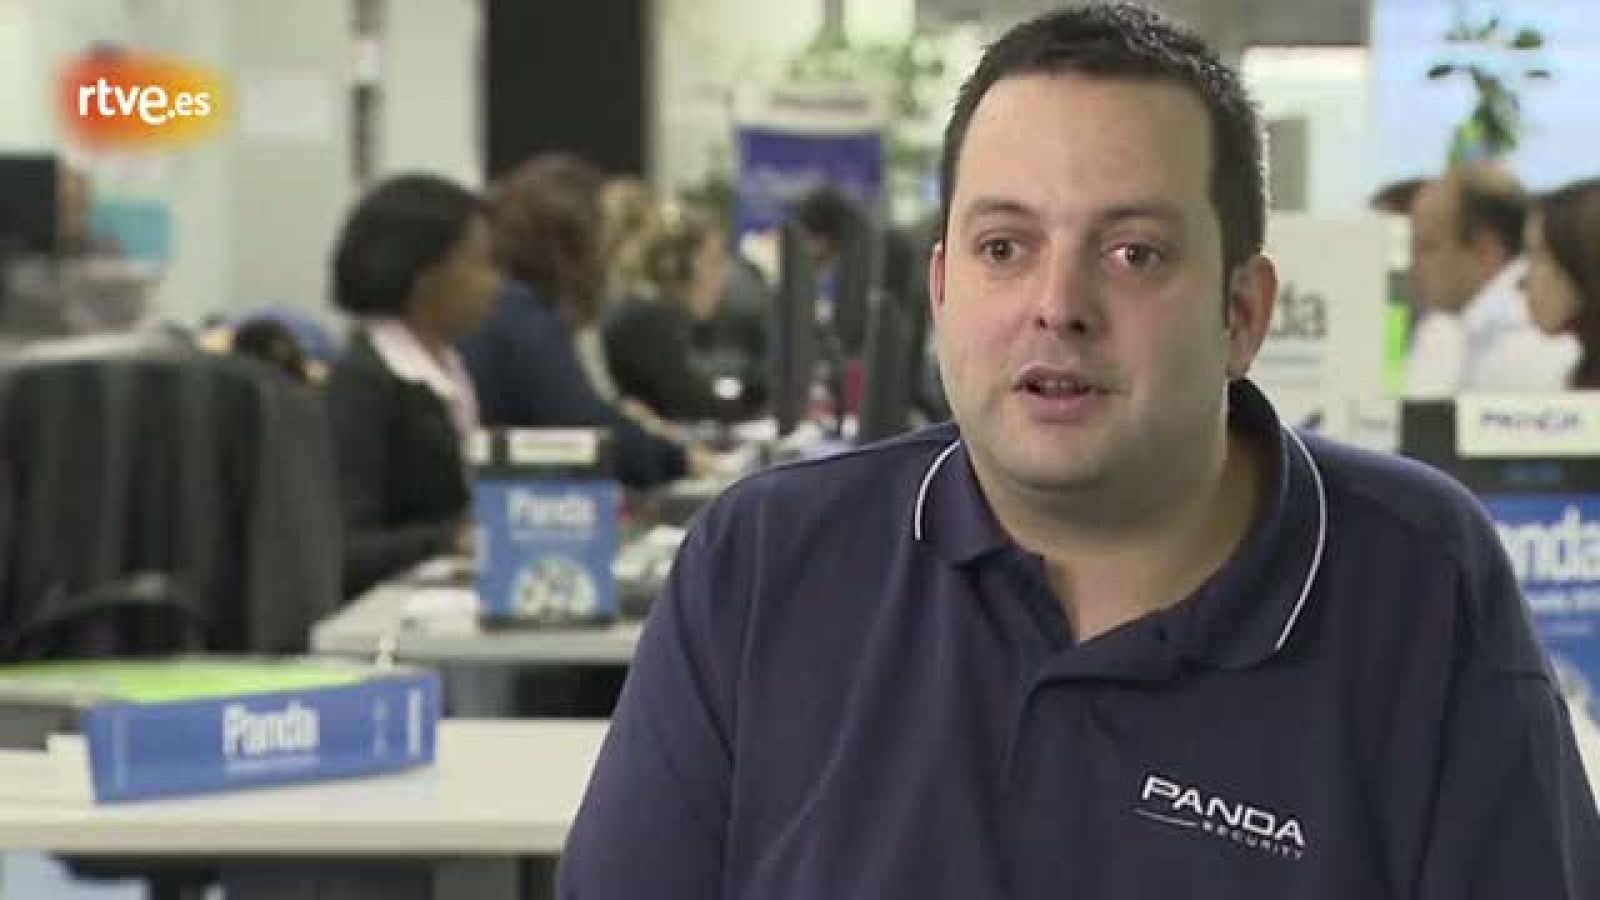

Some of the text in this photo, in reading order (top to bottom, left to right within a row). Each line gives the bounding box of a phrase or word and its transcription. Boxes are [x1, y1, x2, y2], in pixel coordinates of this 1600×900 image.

[1494, 504, 1600, 581] nda
[222, 701, 320, 756] Panda
[1142, 774, 1305, 846] PANDA
